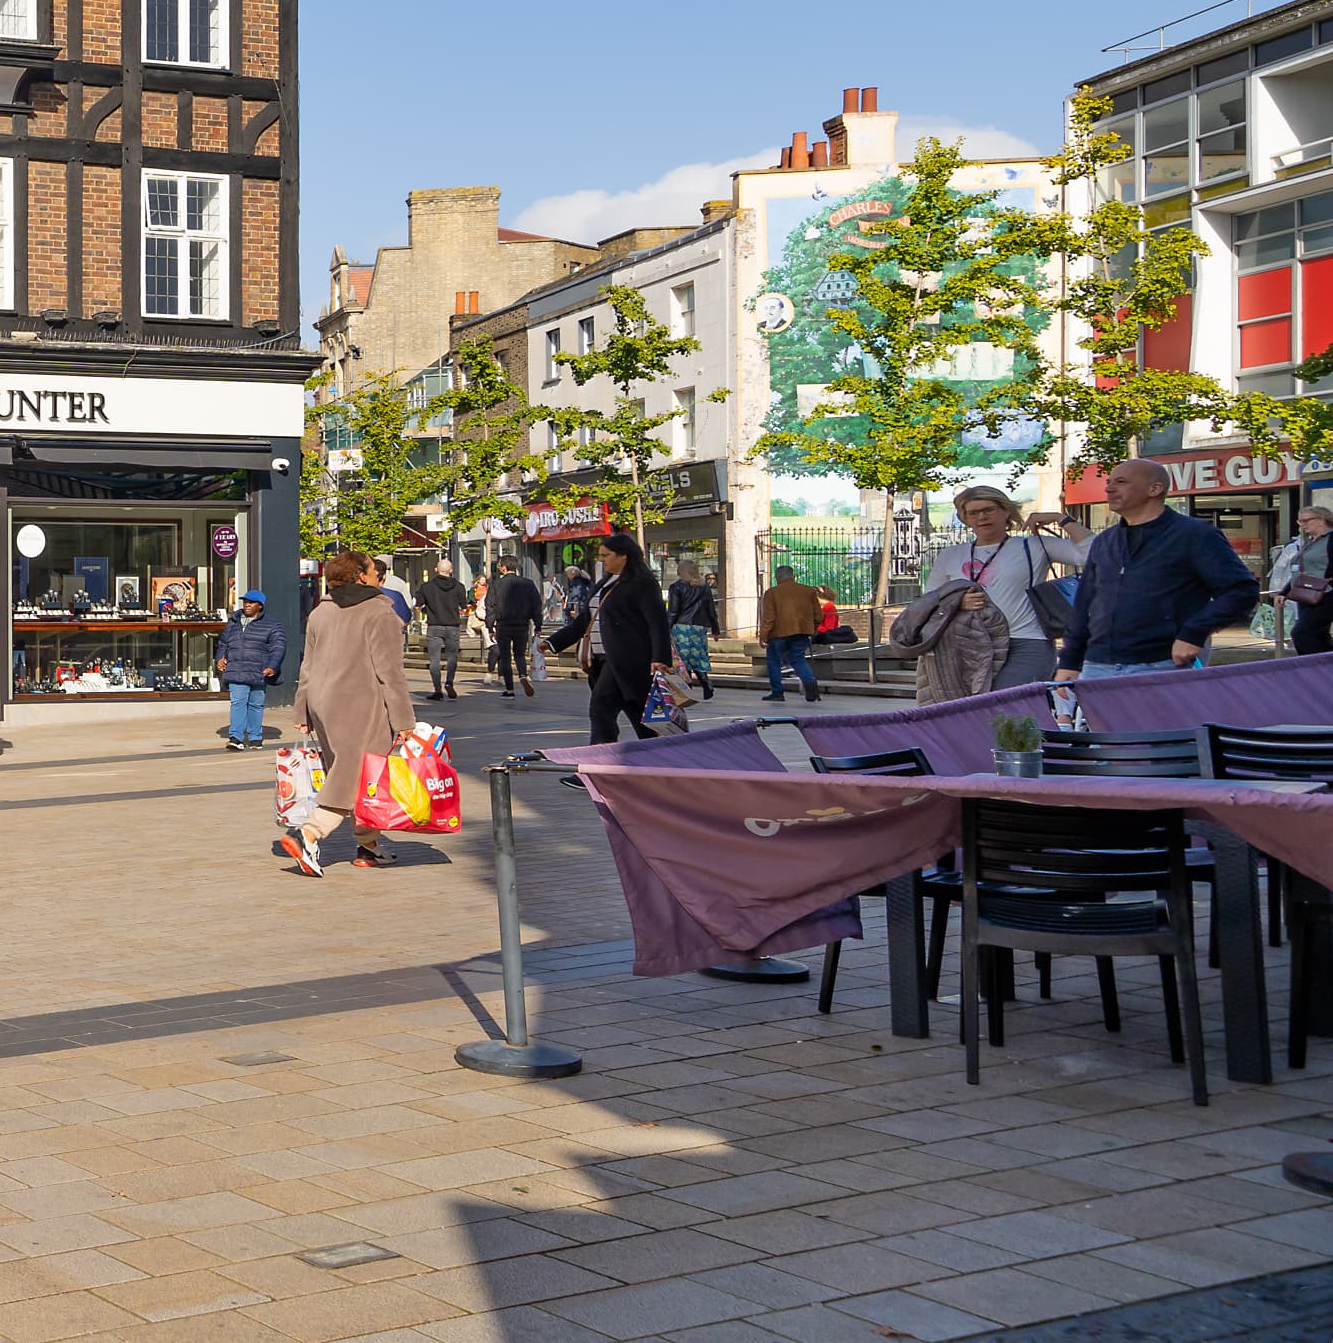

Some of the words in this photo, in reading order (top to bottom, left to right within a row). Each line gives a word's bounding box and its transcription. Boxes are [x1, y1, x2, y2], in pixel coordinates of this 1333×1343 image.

[829, 201, 892, 226] CHARLES
[1163, 459, 1219, 492] IVE
[1225, 452, 1301, 487] GUY
[426, 777, 445, 792] Big
[445, 777, 454, 788] on
